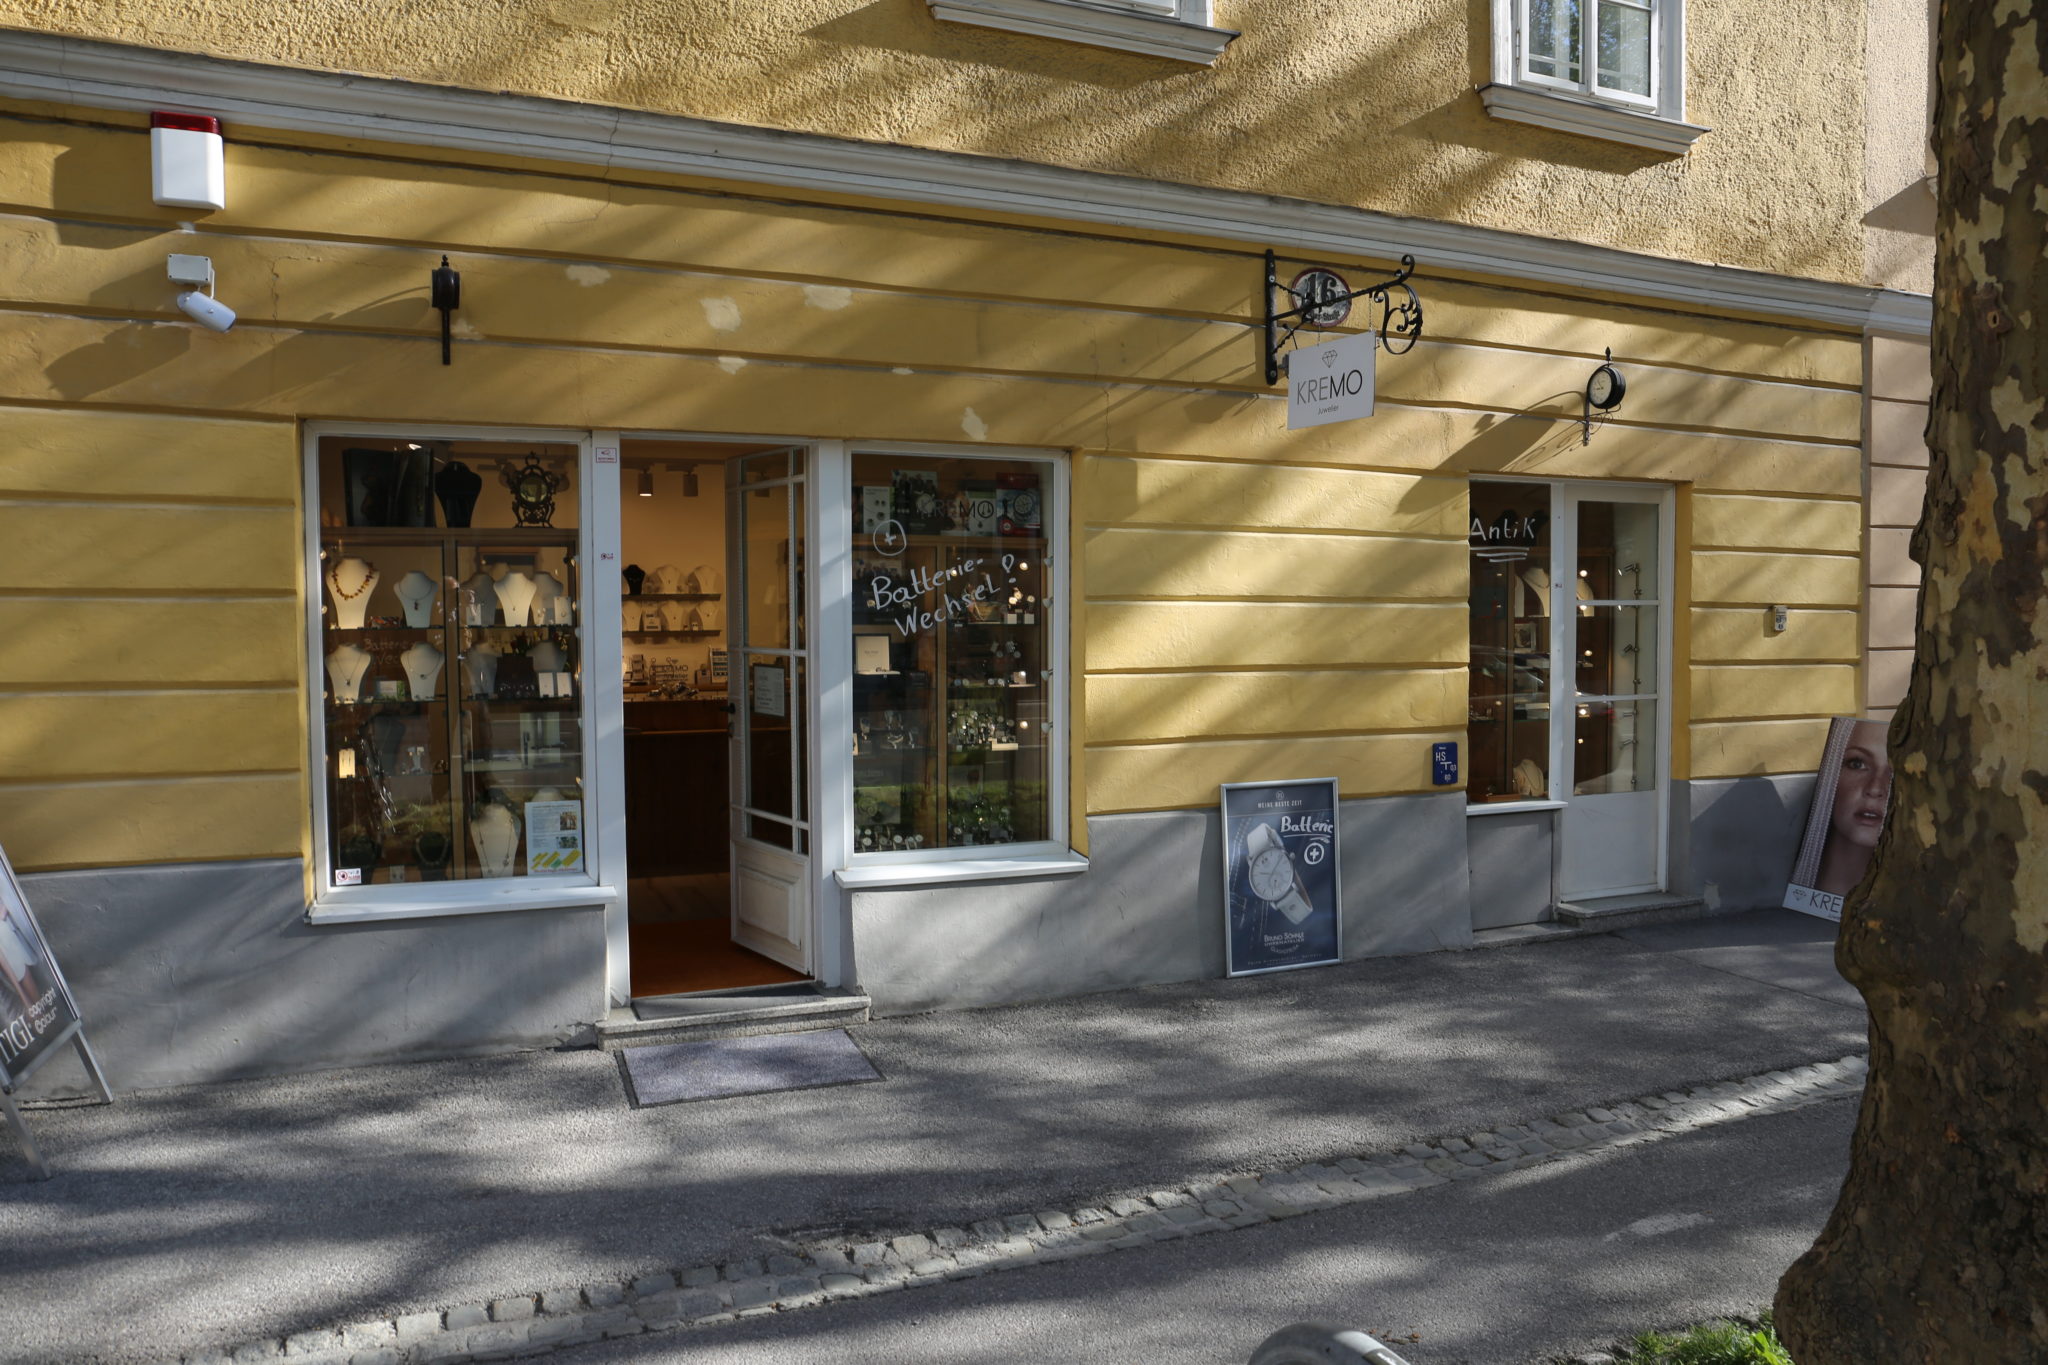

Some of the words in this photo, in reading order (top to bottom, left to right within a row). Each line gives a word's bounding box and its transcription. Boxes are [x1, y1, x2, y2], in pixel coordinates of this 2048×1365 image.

[1296, 369, 1363, 404] KREMO
[1435, 751, 1447, 762] HS
[1809, 891, 1843, 913] KRE
